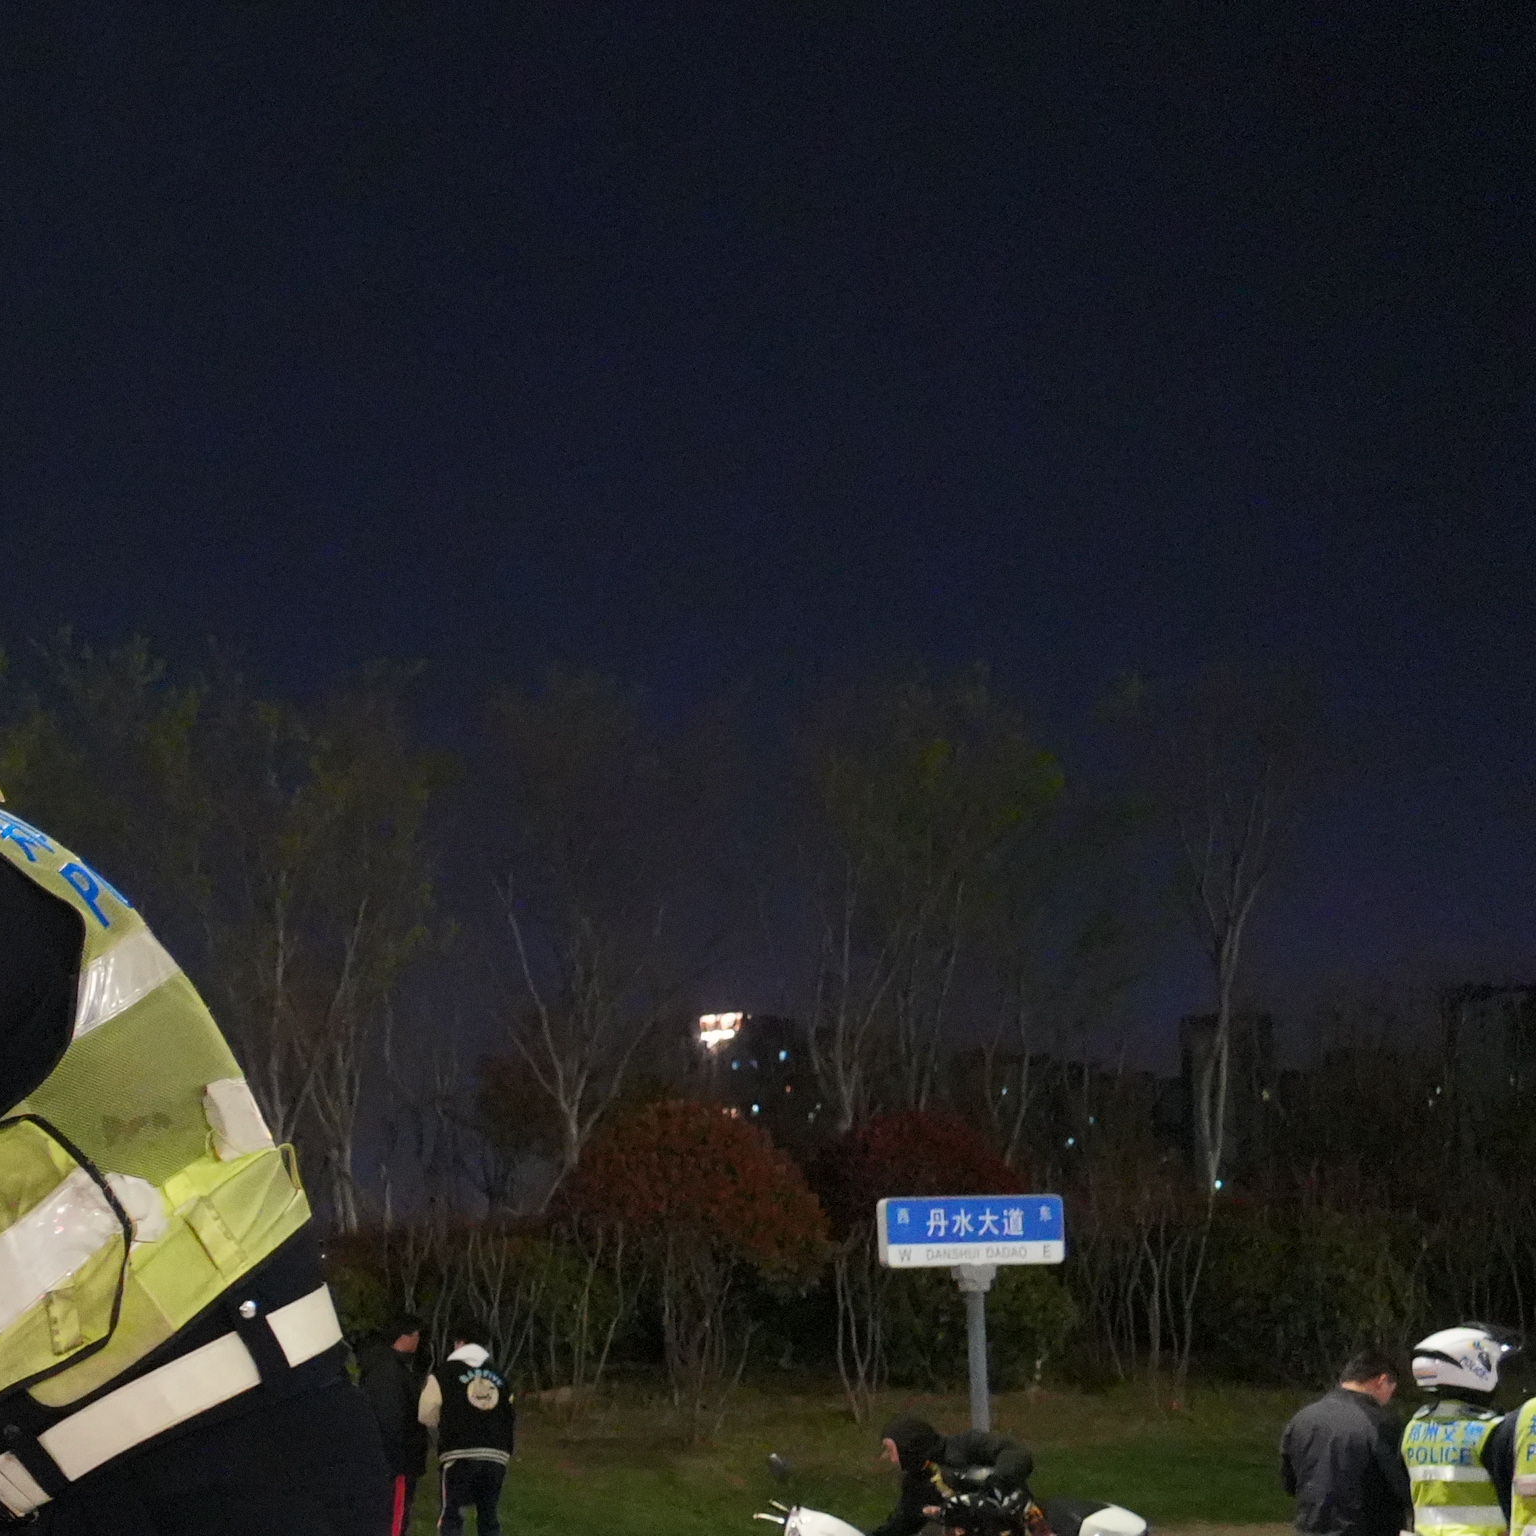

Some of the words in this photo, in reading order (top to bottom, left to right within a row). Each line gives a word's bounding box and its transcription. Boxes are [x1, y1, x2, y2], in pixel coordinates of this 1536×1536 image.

[926, 1207, 1025, 1237] 丹水大道
[898, 1247, 912, 1262] W
[926, 1249, 978, 1261] DANSHUI
[985, 1247, 1028, 1259] DADAO
[1043, 1244, 1051, 1258] E
[1406, 1446, 1472, 1466] POLICE
